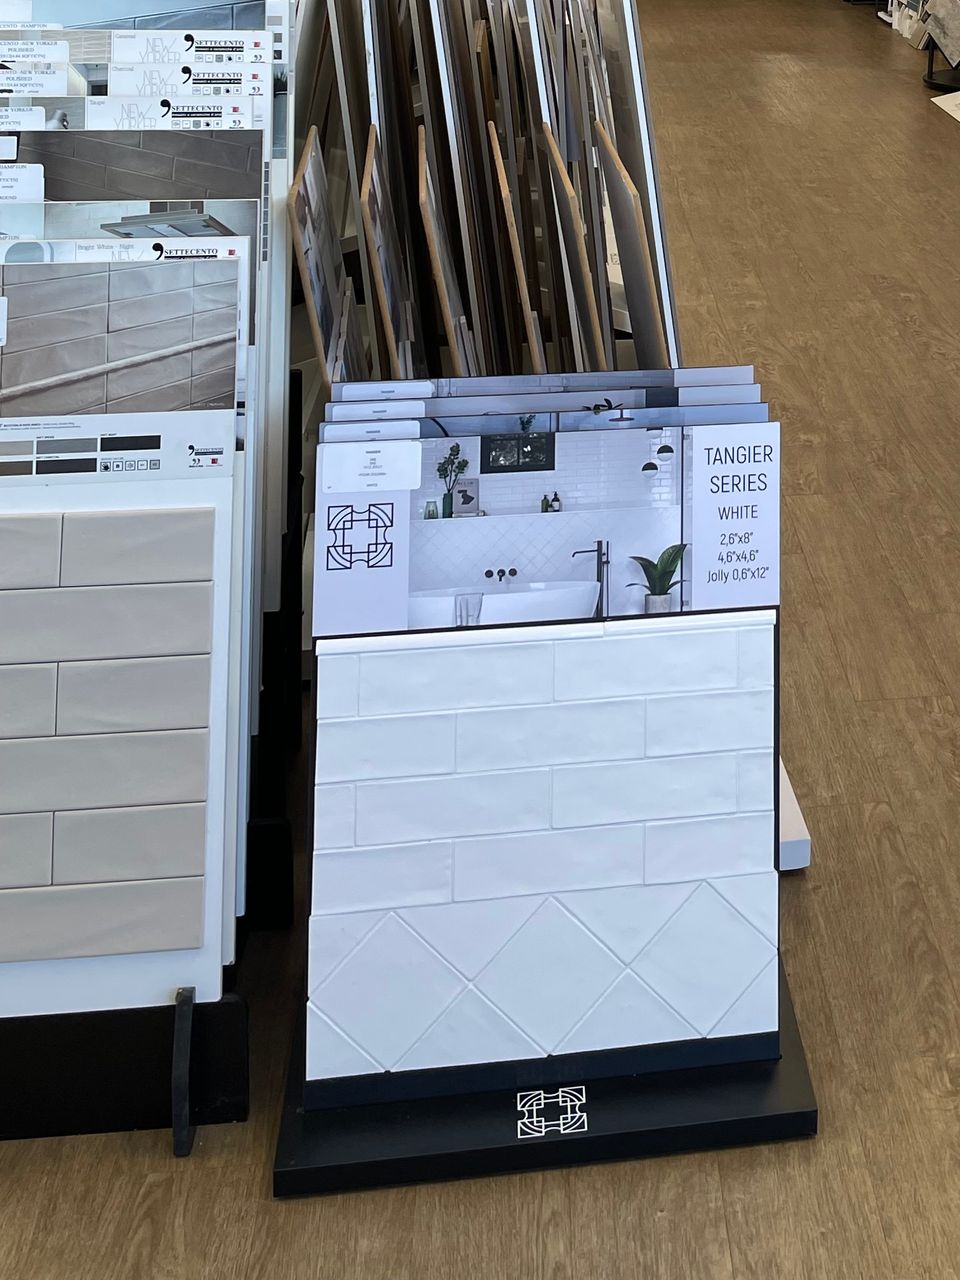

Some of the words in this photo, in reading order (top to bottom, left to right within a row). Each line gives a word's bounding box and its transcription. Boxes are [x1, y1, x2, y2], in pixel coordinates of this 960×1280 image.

[146, 37, 177, 53] NEW
[143, 70, 174, 85] NEW
[120, 103, 153, 119] NEW
[164, 248, 218, 256] SETTECENTO
[704, 445, 773, 465] TANGIER
[710, 473, 767, 494] SERIES
[718, 505, 758, 520] WHITE
[707, 569, 730, 584] Jolly
